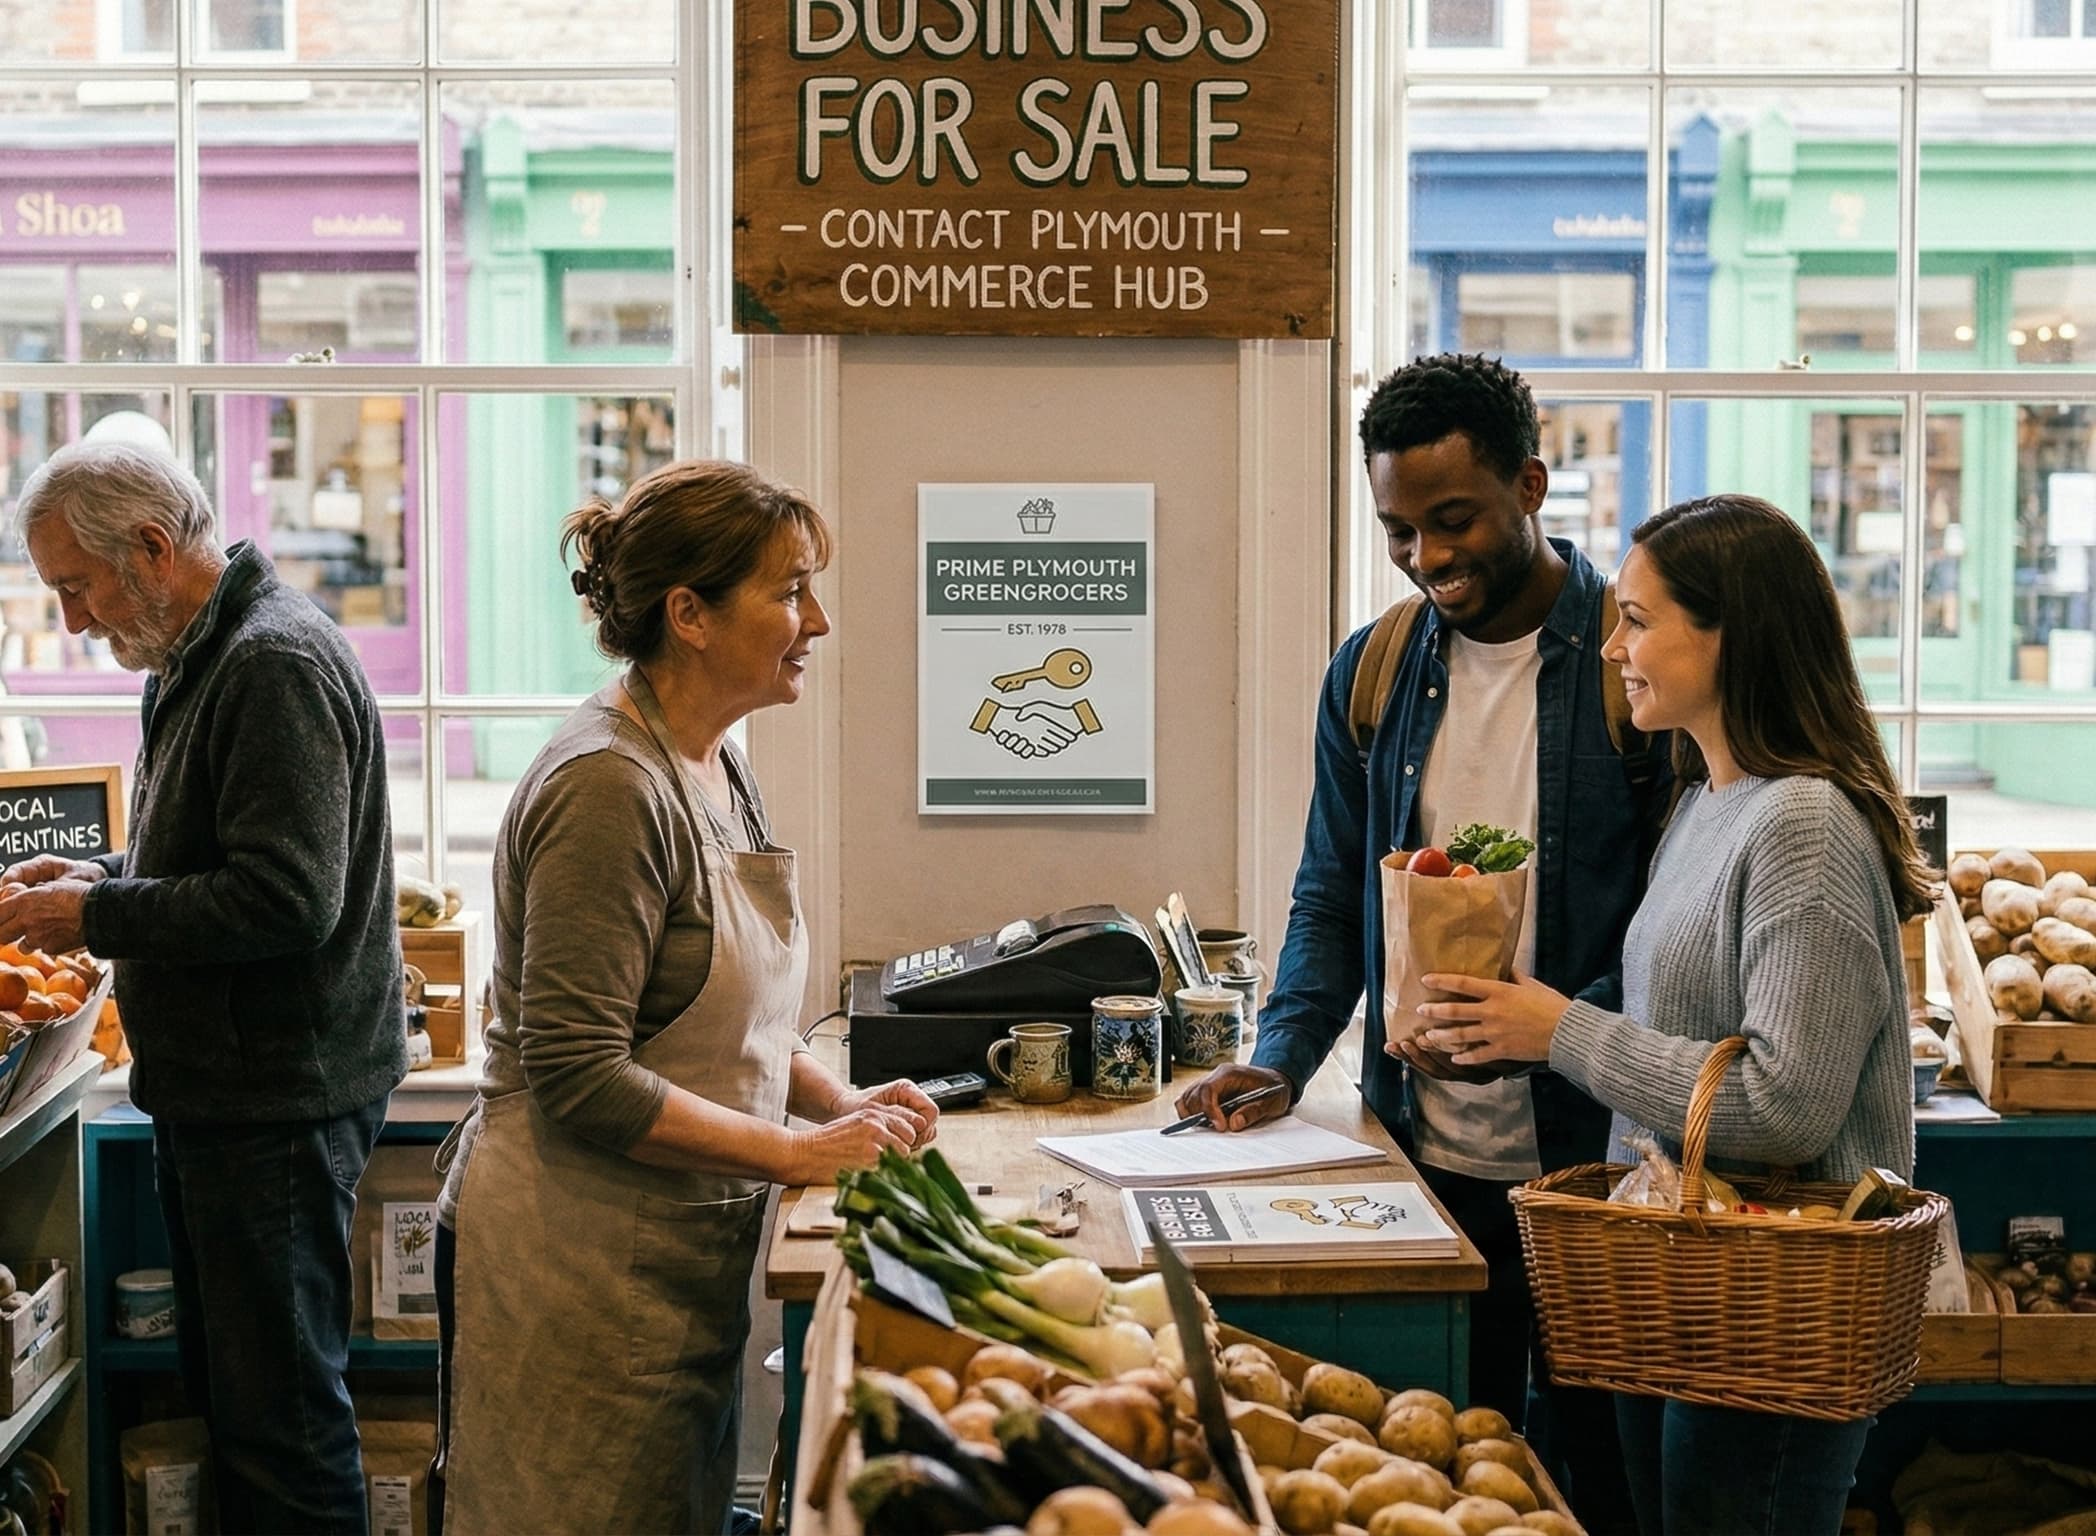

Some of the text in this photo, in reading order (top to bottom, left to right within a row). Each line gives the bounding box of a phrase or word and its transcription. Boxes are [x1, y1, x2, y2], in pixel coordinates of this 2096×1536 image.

[800, 77, 1249, 187] FOR SALE
[16, 191, 126, 237] Shoa
[820, 208, 1241, 251] CONTACT PLYMOUTH
[840, 263, 1209, 310] COMMERCE HUB
[936, 559, 1136, 577] PRIME PLYMOUTH
[943, 583, 1128, 601] GREENGROCERS
[1007, 623, 1067, 636] EST. 1978
